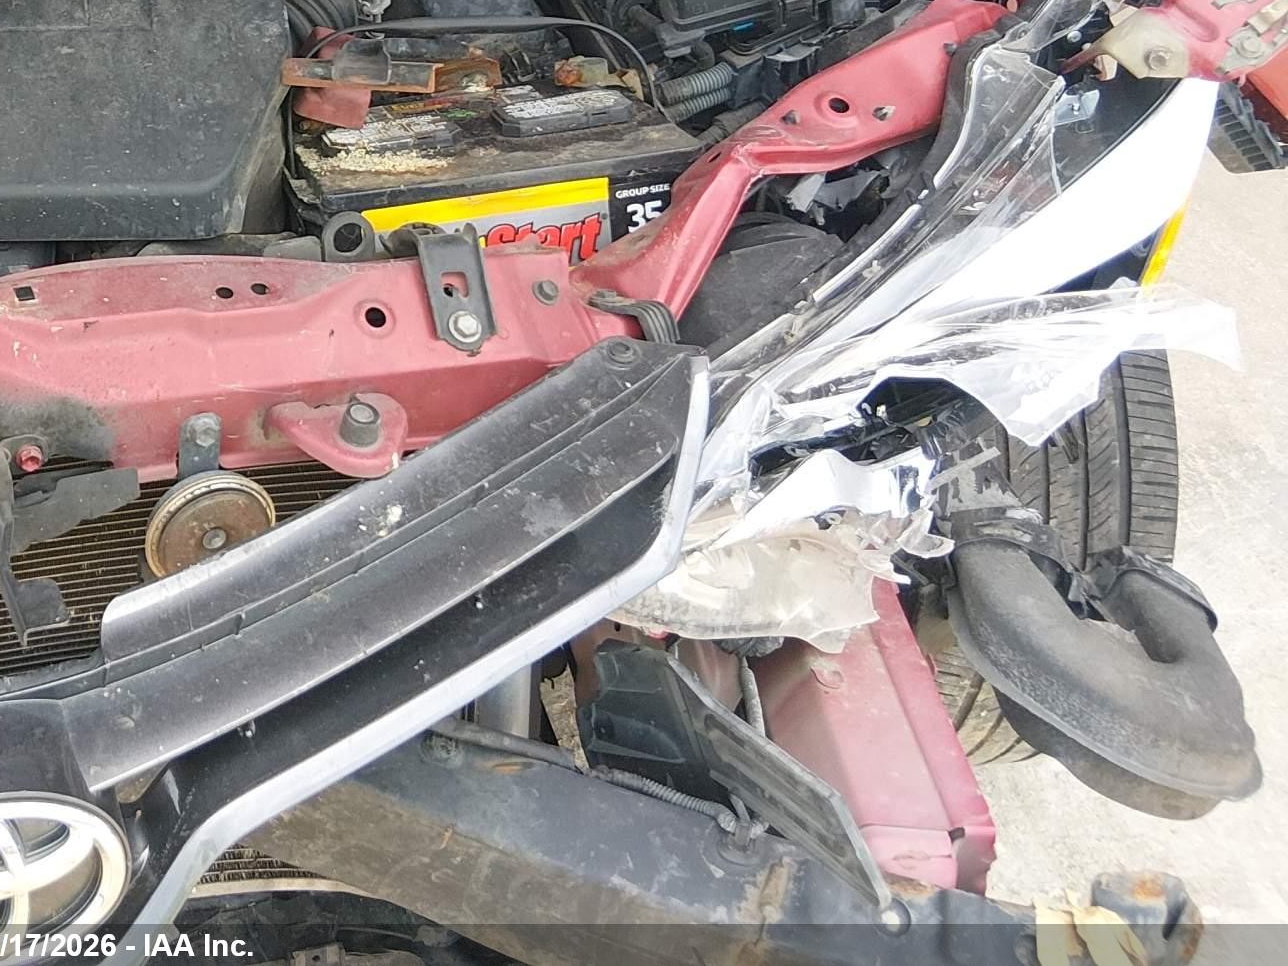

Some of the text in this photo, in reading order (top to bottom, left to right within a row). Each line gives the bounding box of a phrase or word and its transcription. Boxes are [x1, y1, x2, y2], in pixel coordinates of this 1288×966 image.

[615, 182, 671, 200] GROUP SIZE
[626, 200, 663, 233] 35
